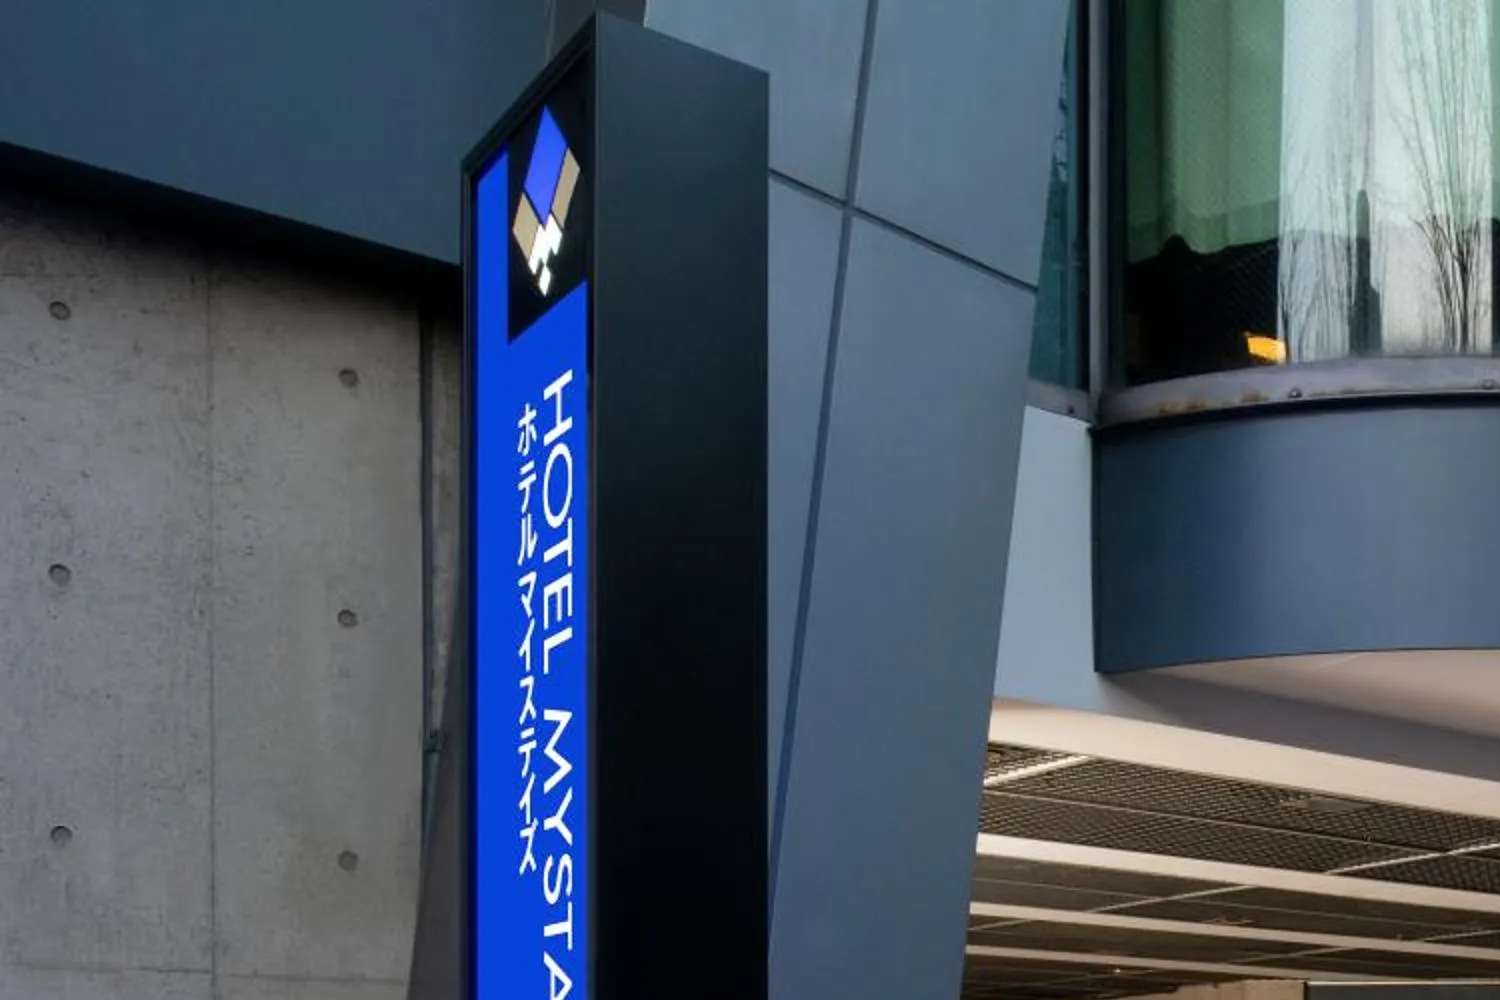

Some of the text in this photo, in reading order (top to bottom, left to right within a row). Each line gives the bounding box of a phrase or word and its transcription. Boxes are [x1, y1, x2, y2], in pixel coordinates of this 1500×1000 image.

[517, 403, 538, 875] ホテルマイステイズ
[543, 369, 573, 675] HOTEL
